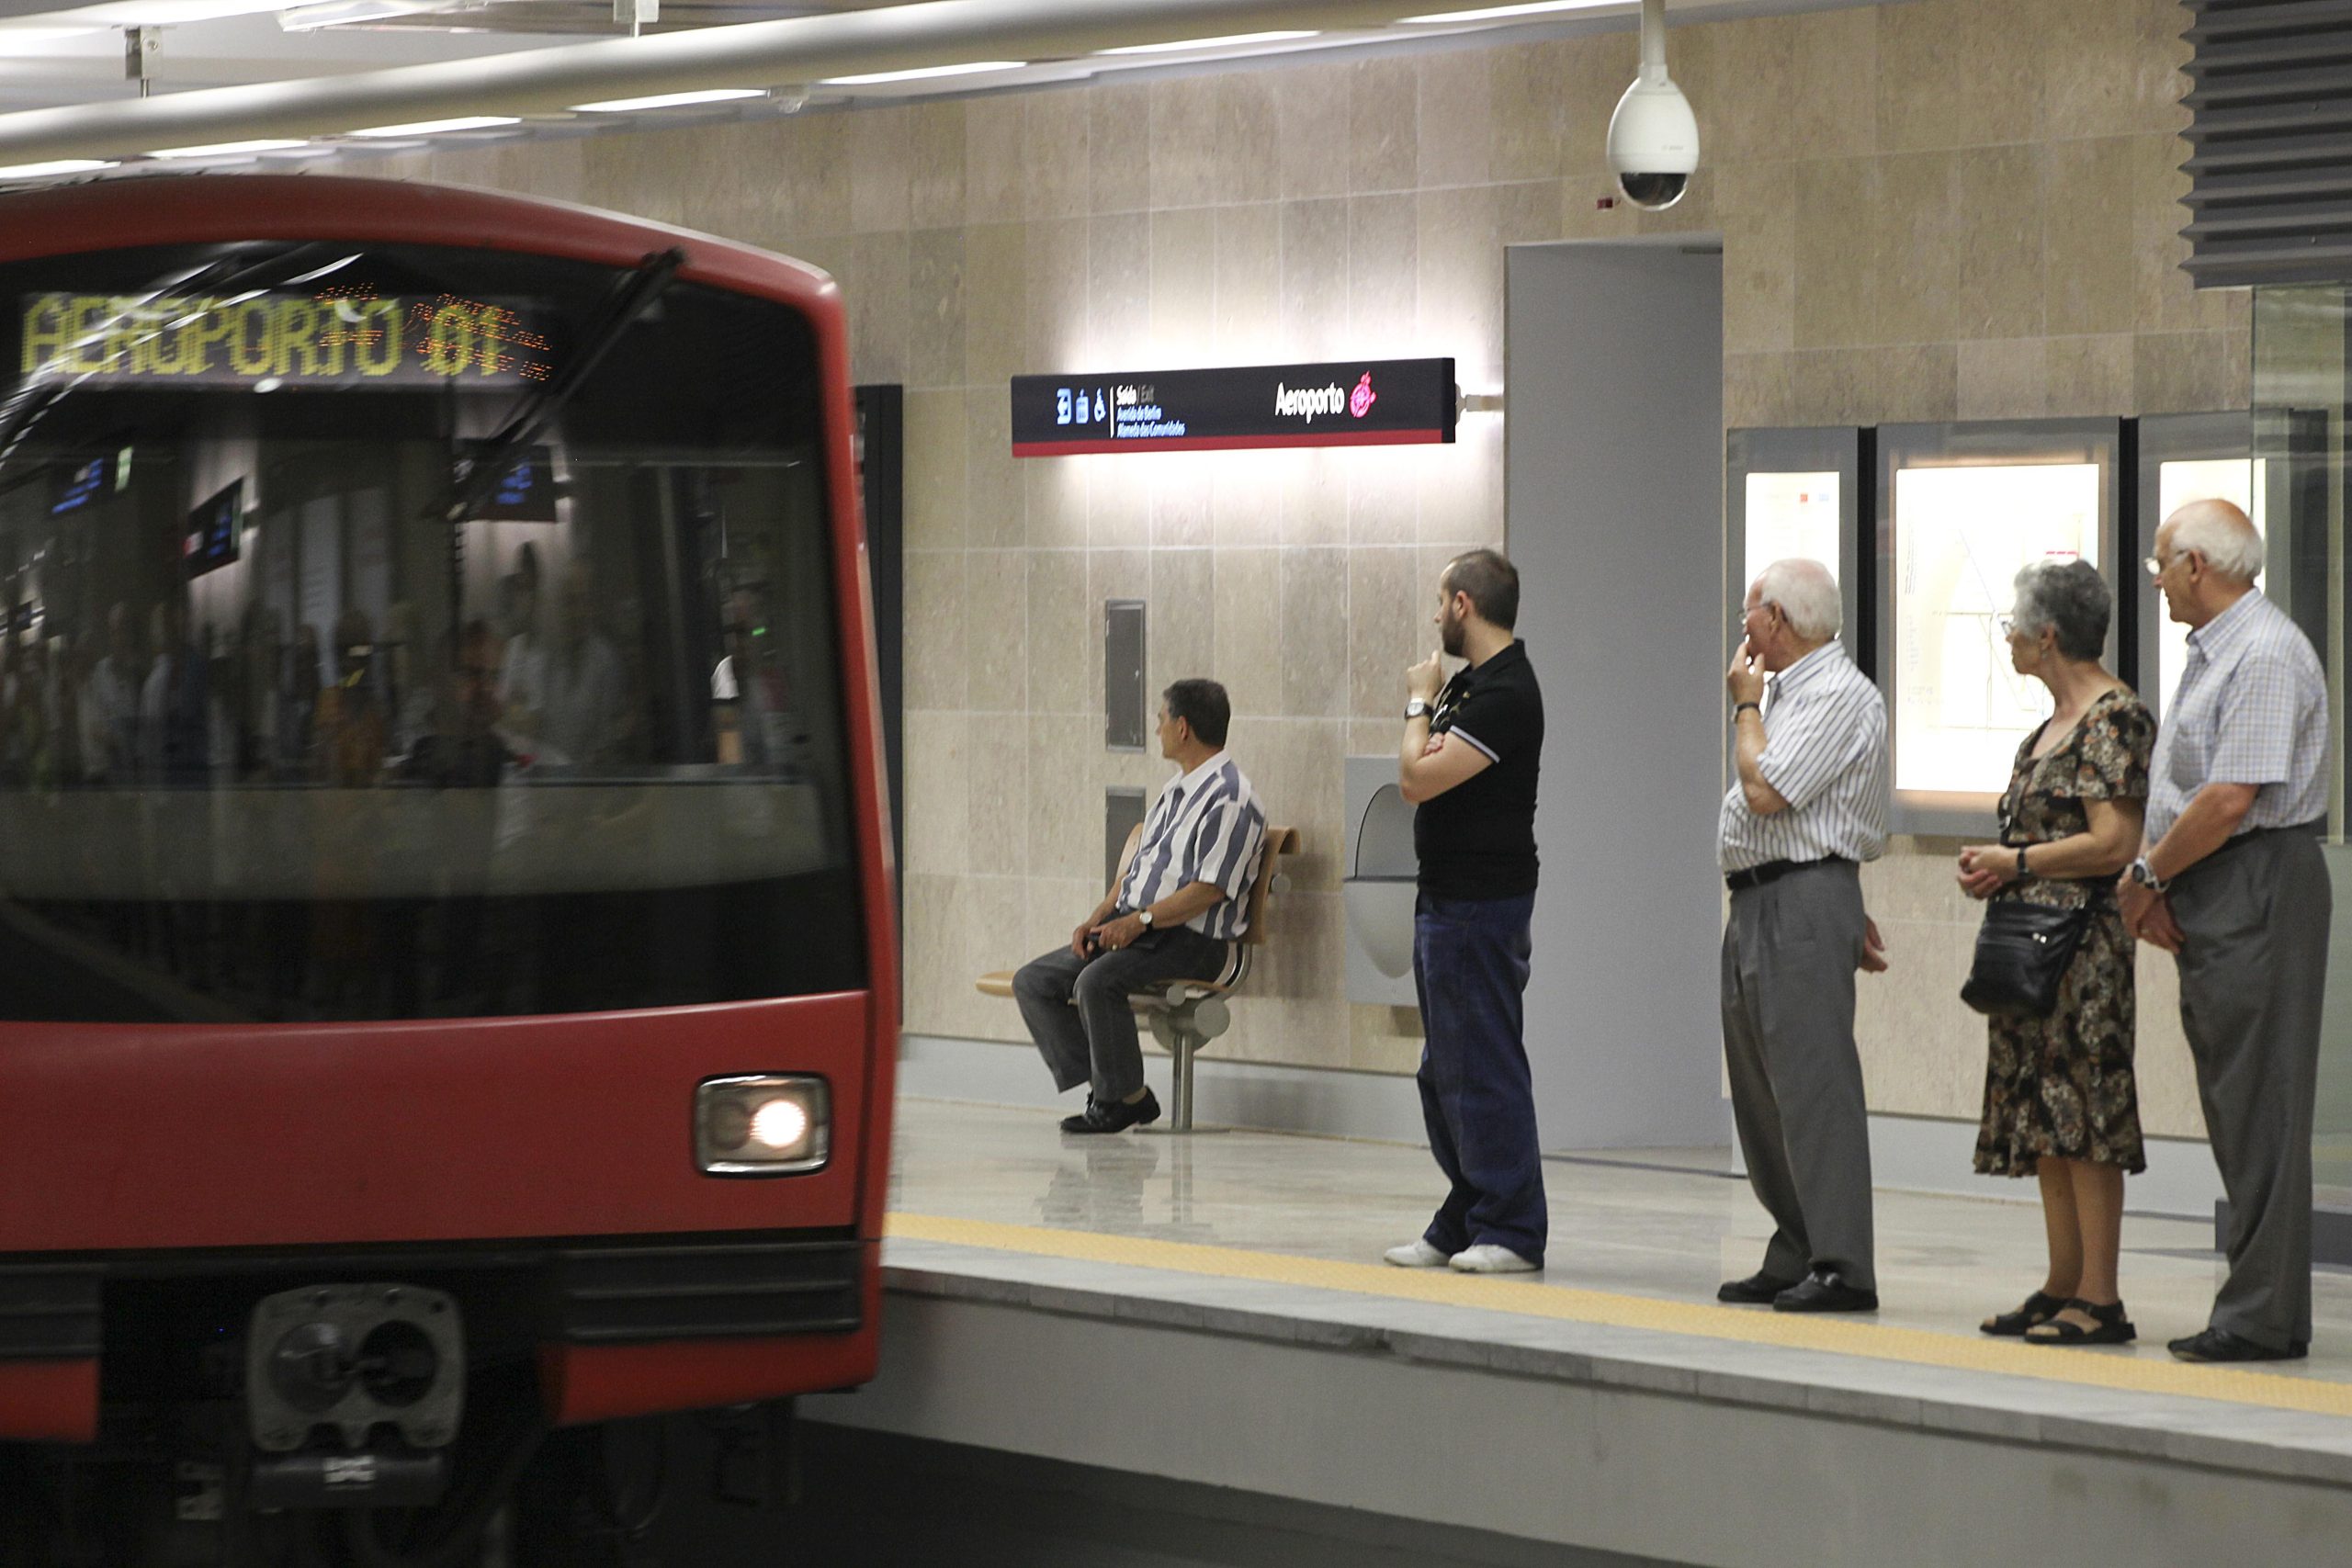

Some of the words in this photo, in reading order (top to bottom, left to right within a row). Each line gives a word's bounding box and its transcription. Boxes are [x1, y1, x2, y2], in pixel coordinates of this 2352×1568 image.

[21, 296, 403, 376] AEROPORTO
[425, 302, 503, 377] 01
[1274, 382, 1345, 423] Aeroporto
[1117, 423, 1140, 438] Alameda
